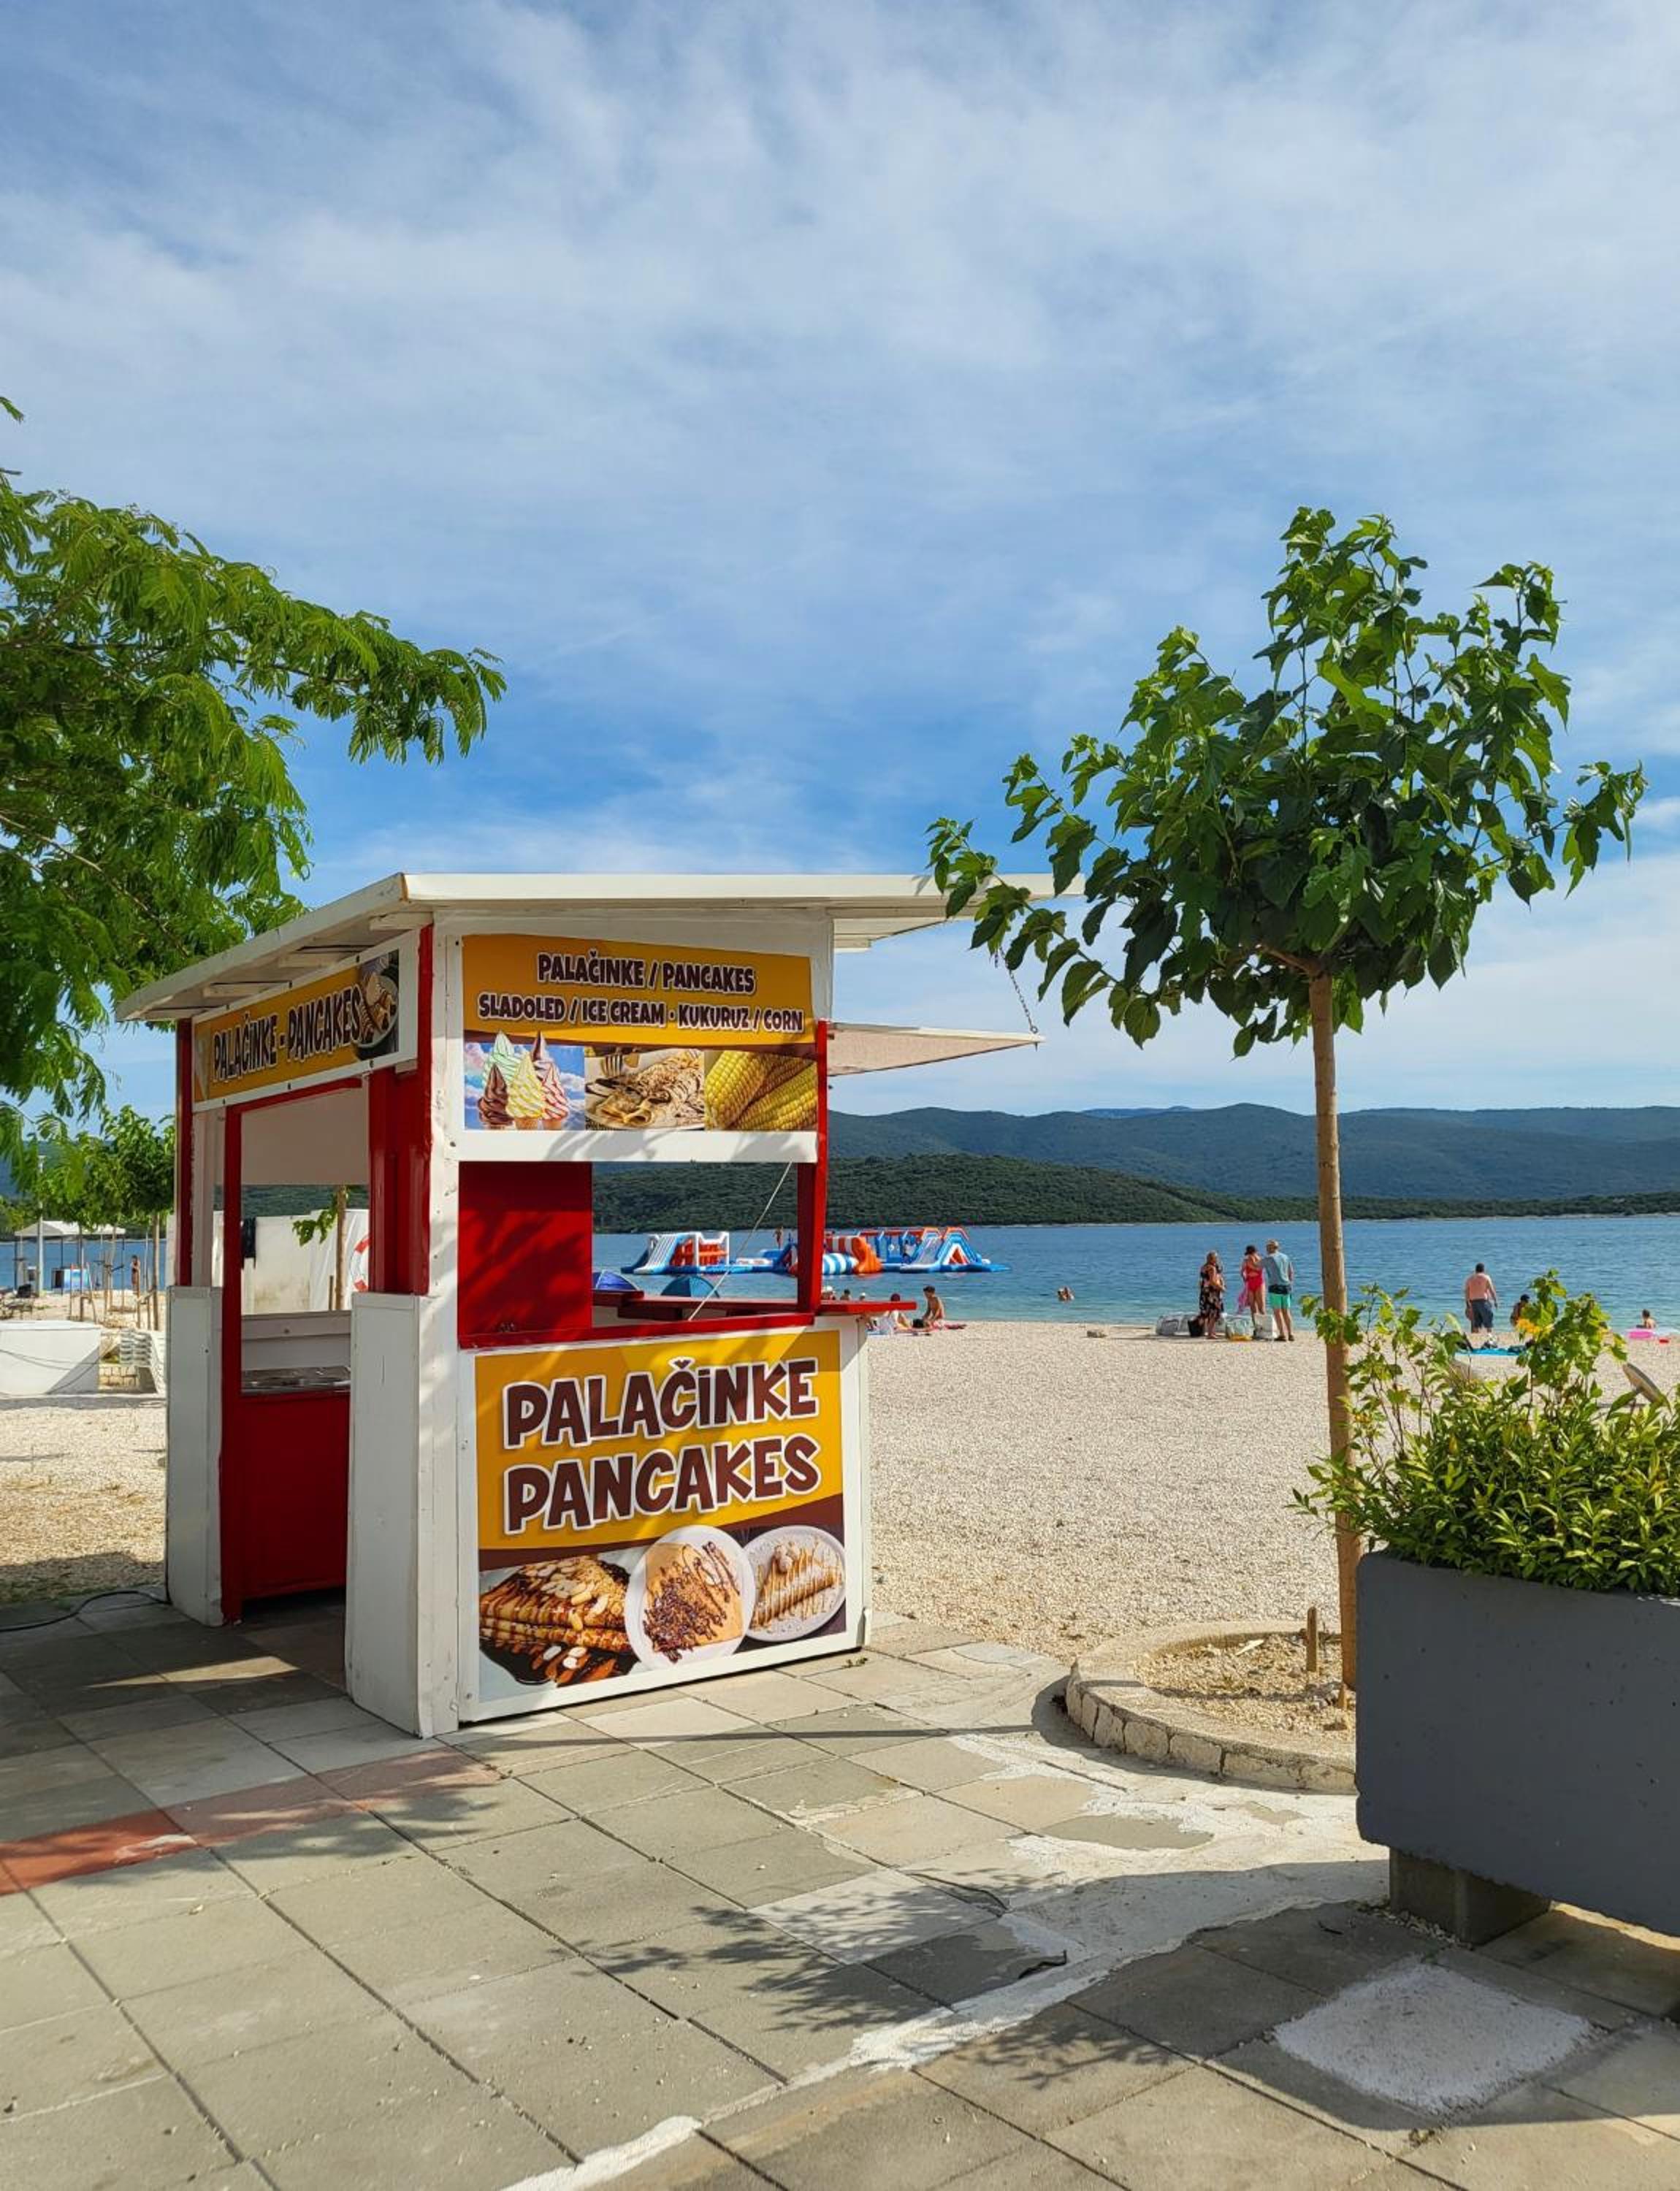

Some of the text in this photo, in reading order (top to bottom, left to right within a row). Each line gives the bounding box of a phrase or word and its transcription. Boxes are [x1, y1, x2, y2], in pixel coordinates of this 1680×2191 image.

[663, 962, 755, 993] PANCAKES
[287, 984, 362, 1062] PANCAKES
[478, 993, 565, 1021] SLADOLED
[583, 998, 608, 1023] ICE
[610, 1001, 665, 1027] CREAM
[678, 1004, 749, 1030] KUKURUZ
[763, 1008, 804, 1031] CORN
[504, 1435, 822, 1535] PANCAKES
